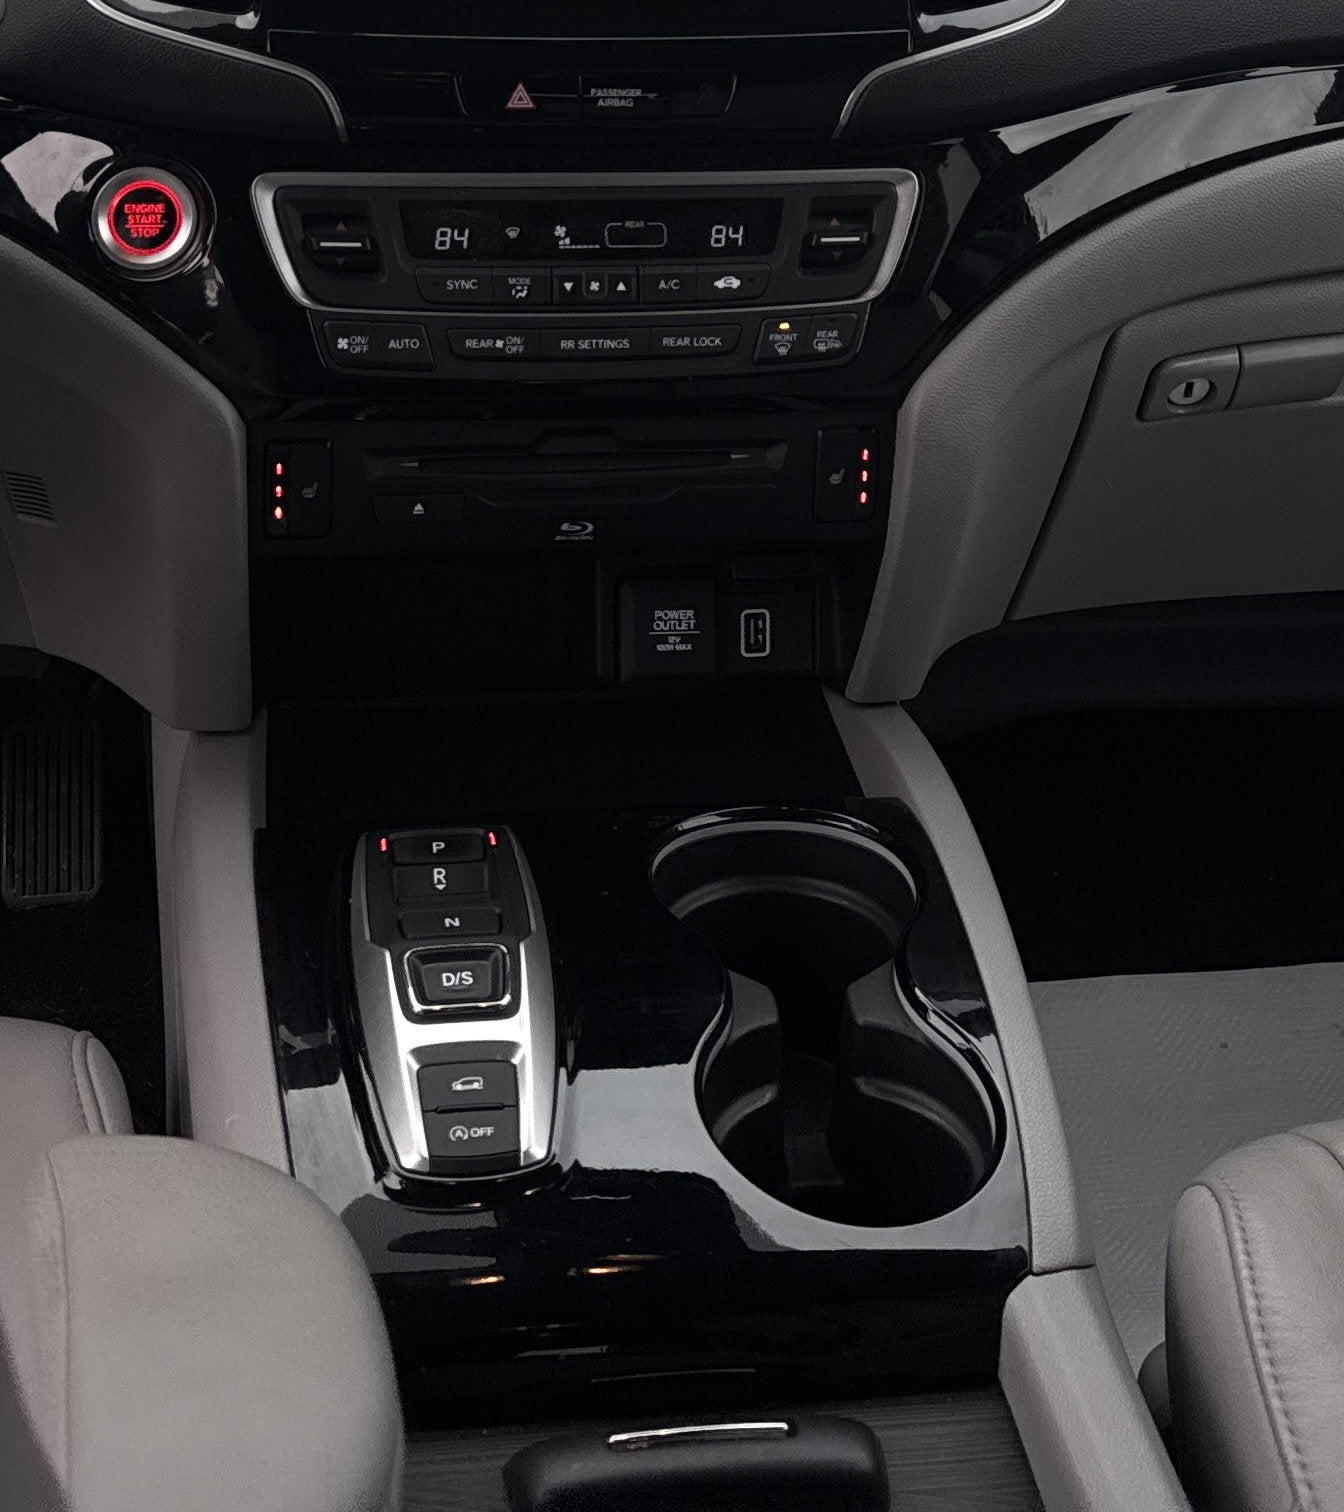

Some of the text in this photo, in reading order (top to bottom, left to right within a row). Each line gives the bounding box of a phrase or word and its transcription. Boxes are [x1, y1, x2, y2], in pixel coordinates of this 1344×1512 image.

[590, 88, 642, 97] PASSENGER
[597, 98, 635, 107] AIRBAG
[124, 203, 165, 213] ENGINE
[128, 214, 162, 225] START
[130, 227, 160, 238] STOP
[710, 225, 744, 248] 84
[434, 227, 470, 250] 84
[445, 279, 479, 290] SYNC
[508, 277, 531, 285] MODE
[658, 279, 681, 290] A/C
[349, 335, 369, 345] ON/
[769, 333, 798, 342] FRONT
[816, 330, 839, 339] REAR
[388, 339, 420, 350] AUTO
[465, 338, 494, 349] REAR
[505, 335, 525, 346] ON/
[561, 338, 631, 350] RR SETTINGS
[662, 335, 722, 347] REAR LOCK
[349, 344, 369, 355] OFF
[505, 344, 525, 354] OFF
[654, 609, 695, 620] POWER
[653, 620, 696, 631] OUTLET
[432, 841, 446, 854] P
[433, 867, 446, 884] R
[444, 917, 461, 928] N
[441, 971, 474, 988] D/S
[470, 1126, 495, 1138] OFF
